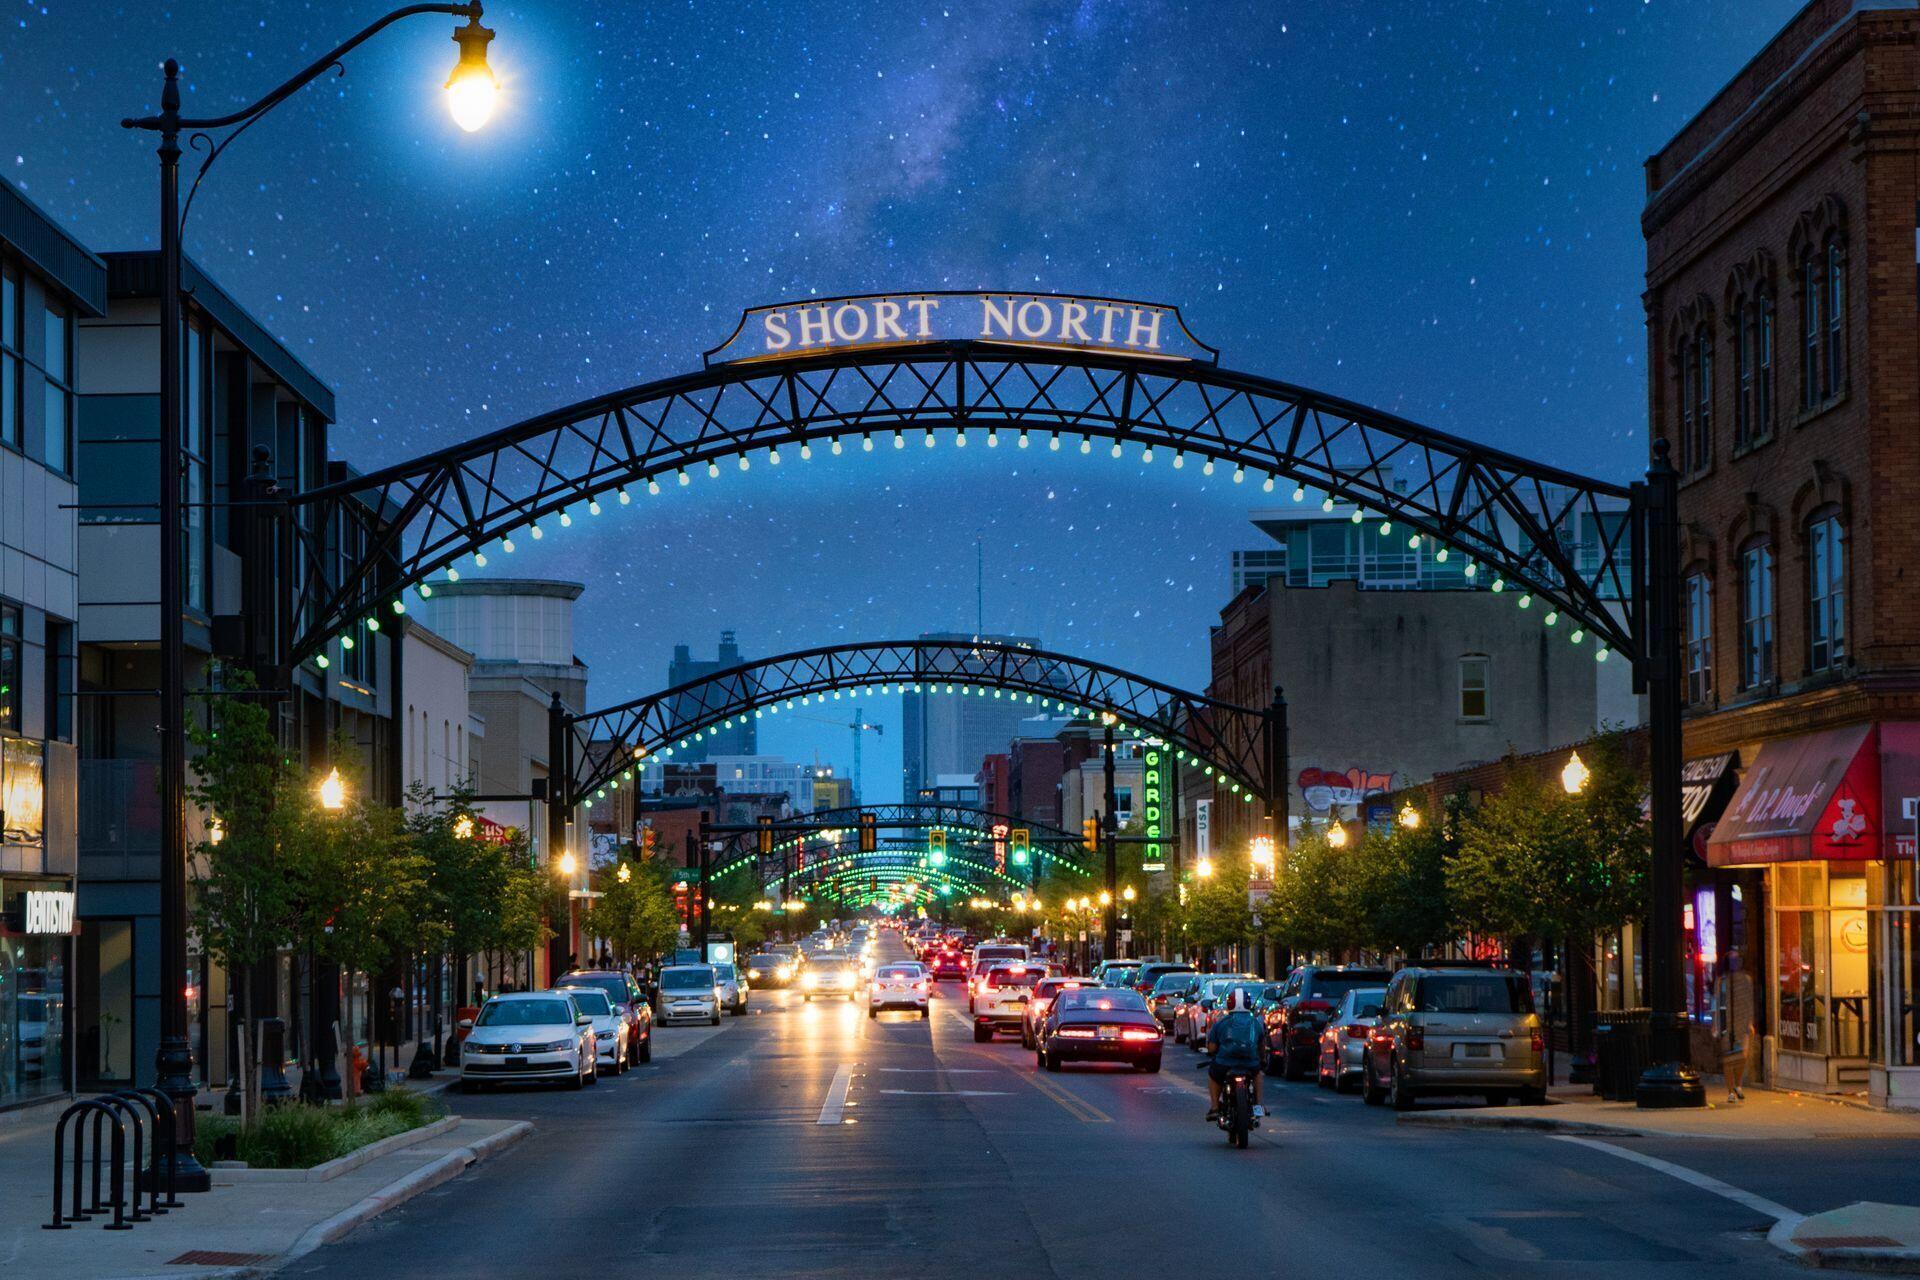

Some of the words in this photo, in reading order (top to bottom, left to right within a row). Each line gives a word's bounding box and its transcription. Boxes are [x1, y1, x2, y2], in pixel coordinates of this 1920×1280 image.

[765, 300, 939, 350] SHORT
[981, 299, 1165, 349] NORTH
[1198, 805, 1207, 830] USA
[26, 891, 75, 934] DENTISTRY
